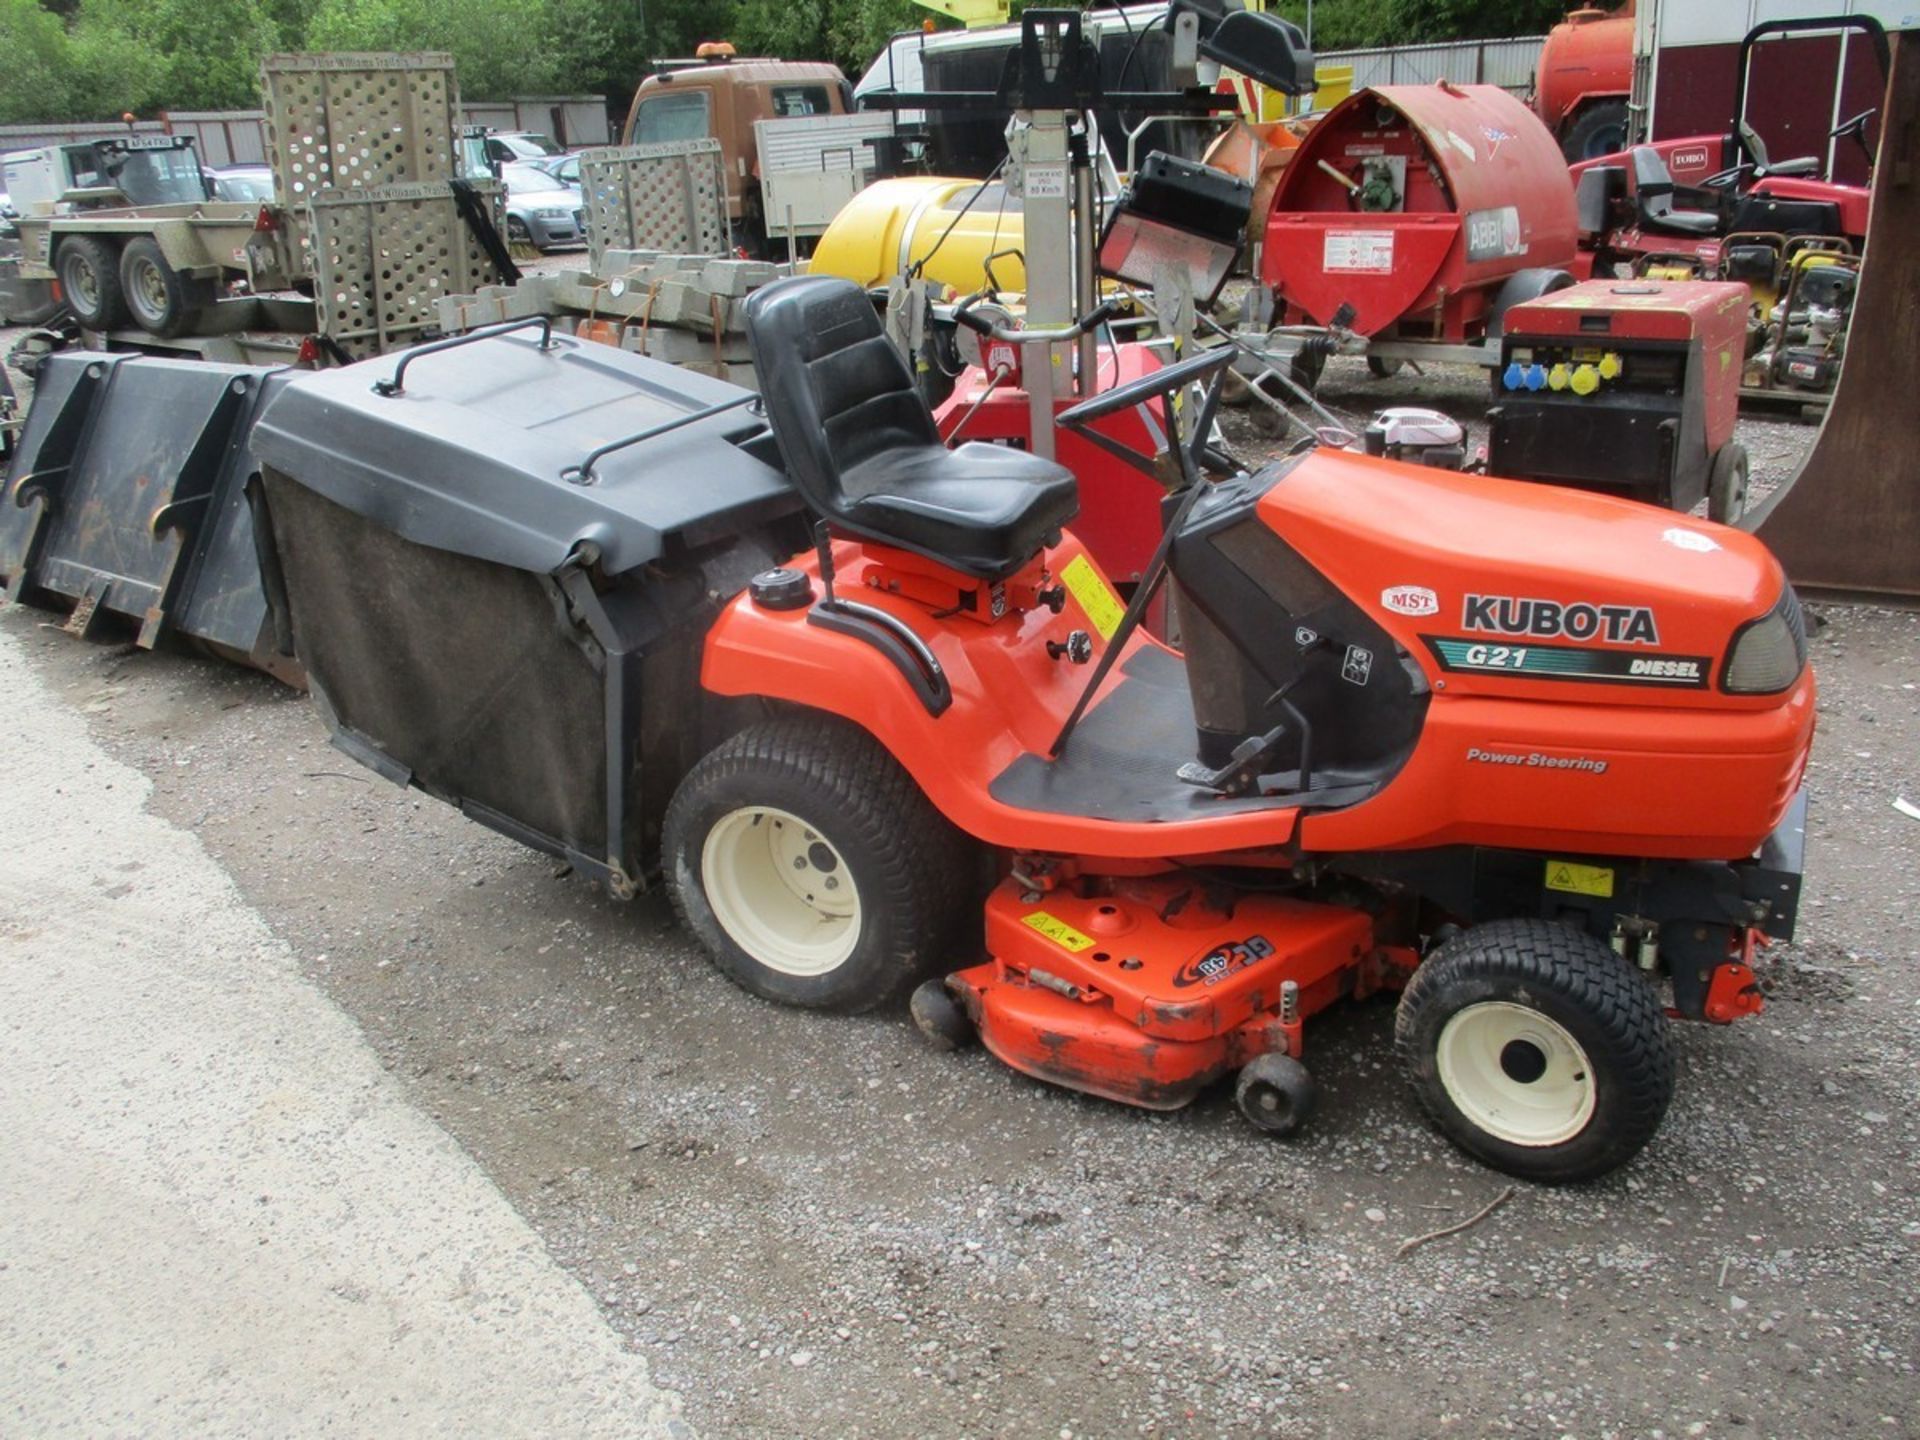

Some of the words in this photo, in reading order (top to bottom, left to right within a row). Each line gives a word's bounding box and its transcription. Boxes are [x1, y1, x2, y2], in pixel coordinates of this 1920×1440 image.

[1675, 153, 1705, 165] TORO
[1391, 592, 1433, 609] MST
[1461, 593, 1660, 645] KUBOTA
[1465, 645, 1528, 668] G21
[1629, 658, 1701, 678] DIESEL
[1467, 748, 1526, 765] Power
[1526, 753, 1608, 774] Steering
[1199, 957, 1228, 976] 48
